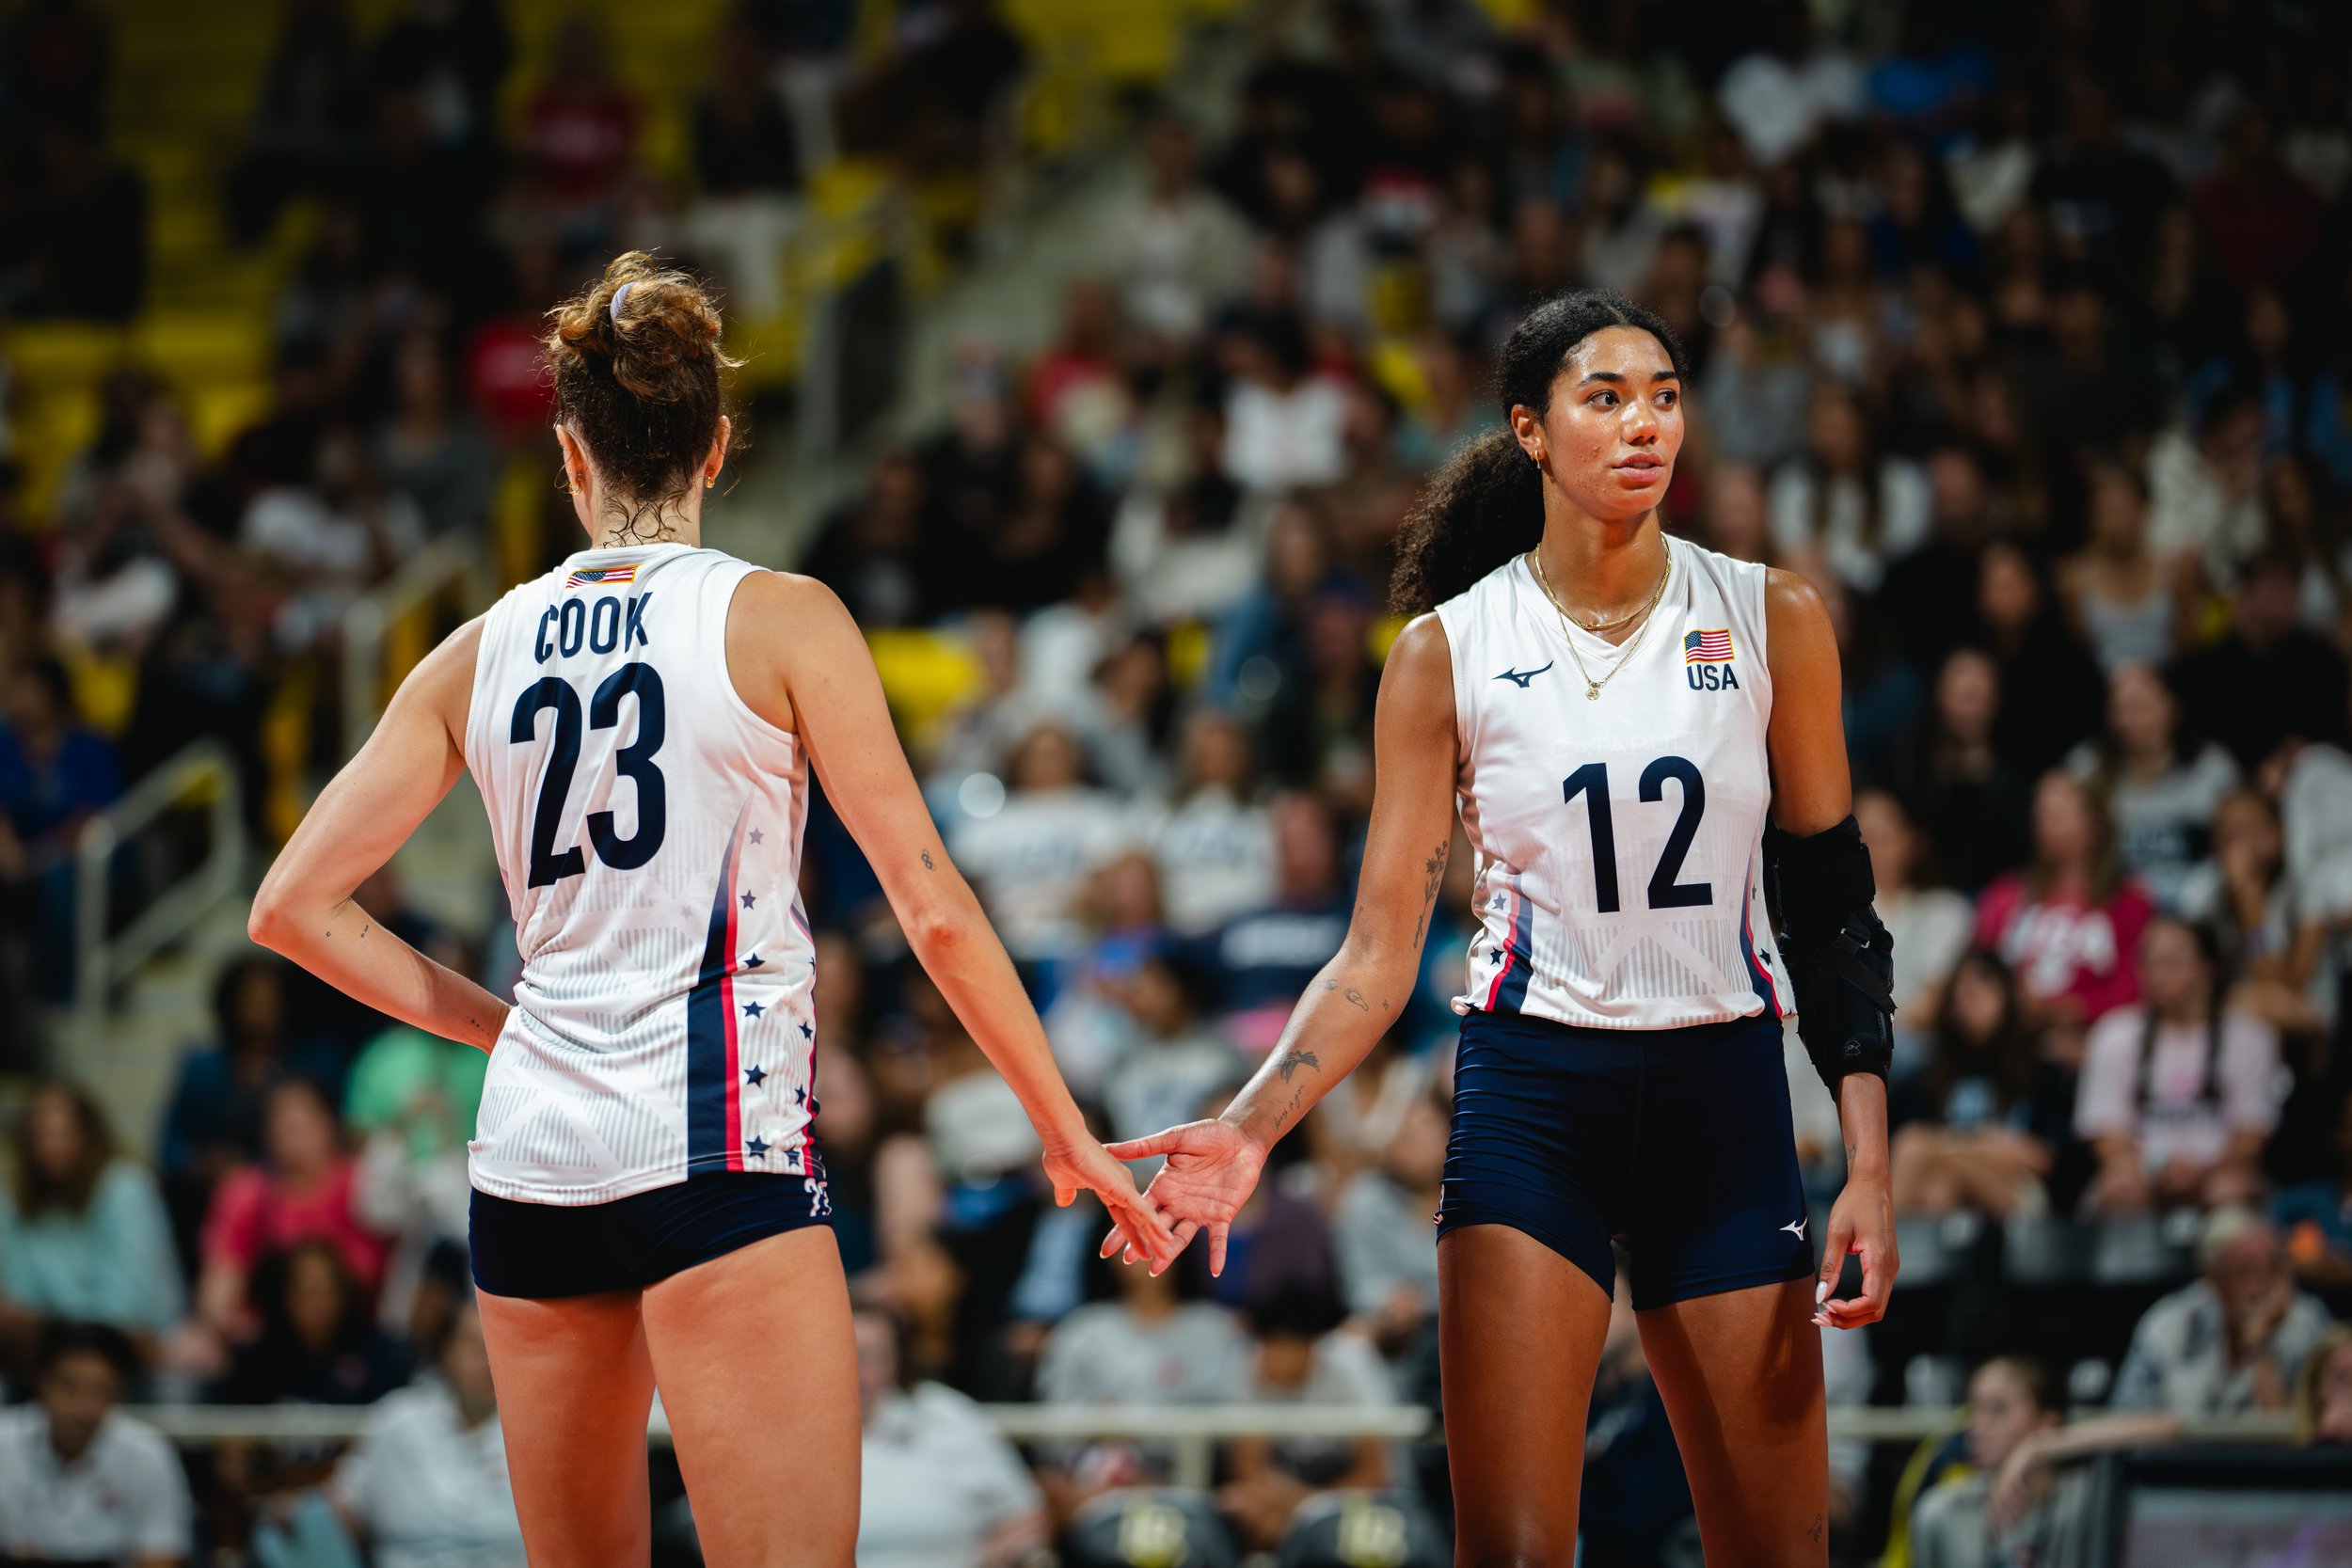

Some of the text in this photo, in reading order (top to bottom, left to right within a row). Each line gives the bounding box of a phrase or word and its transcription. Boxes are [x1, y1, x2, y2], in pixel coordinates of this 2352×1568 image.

[534, 592, 654, 665] COOK
[1686, 663, 1740, 691] USA
[509, 661, 666, 890] 23
[1562, 755, 1713, 914] 12
